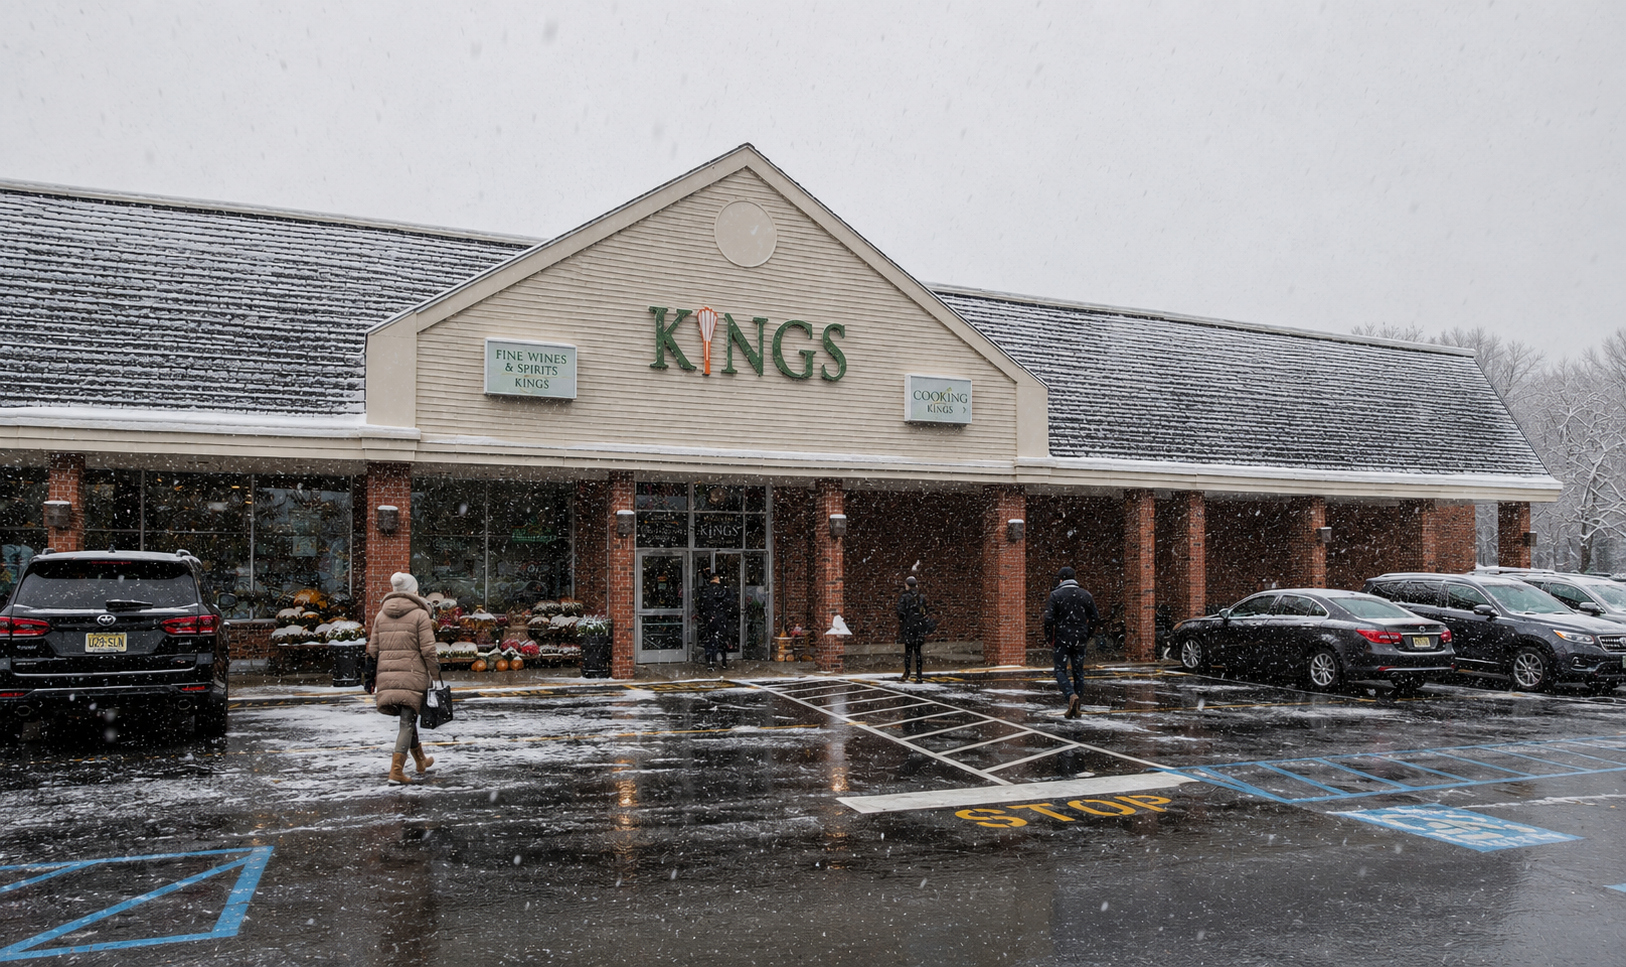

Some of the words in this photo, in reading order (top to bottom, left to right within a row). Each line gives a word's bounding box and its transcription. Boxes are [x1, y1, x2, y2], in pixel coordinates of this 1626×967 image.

[648, 305, 847, 382] KINGS
[496, 349, 523, 361] FINE
[528, 352, 567, 364] WINES
[505, 362, 513, 372] &
[518, 363, 558, 375] SPIRITS
[515, 378, 549, 389] KINGS
[913, 390, 967, 403] COOKING
[927, 404, 953, 414] KINGS
[954, 794, 1173, 828] STOP
